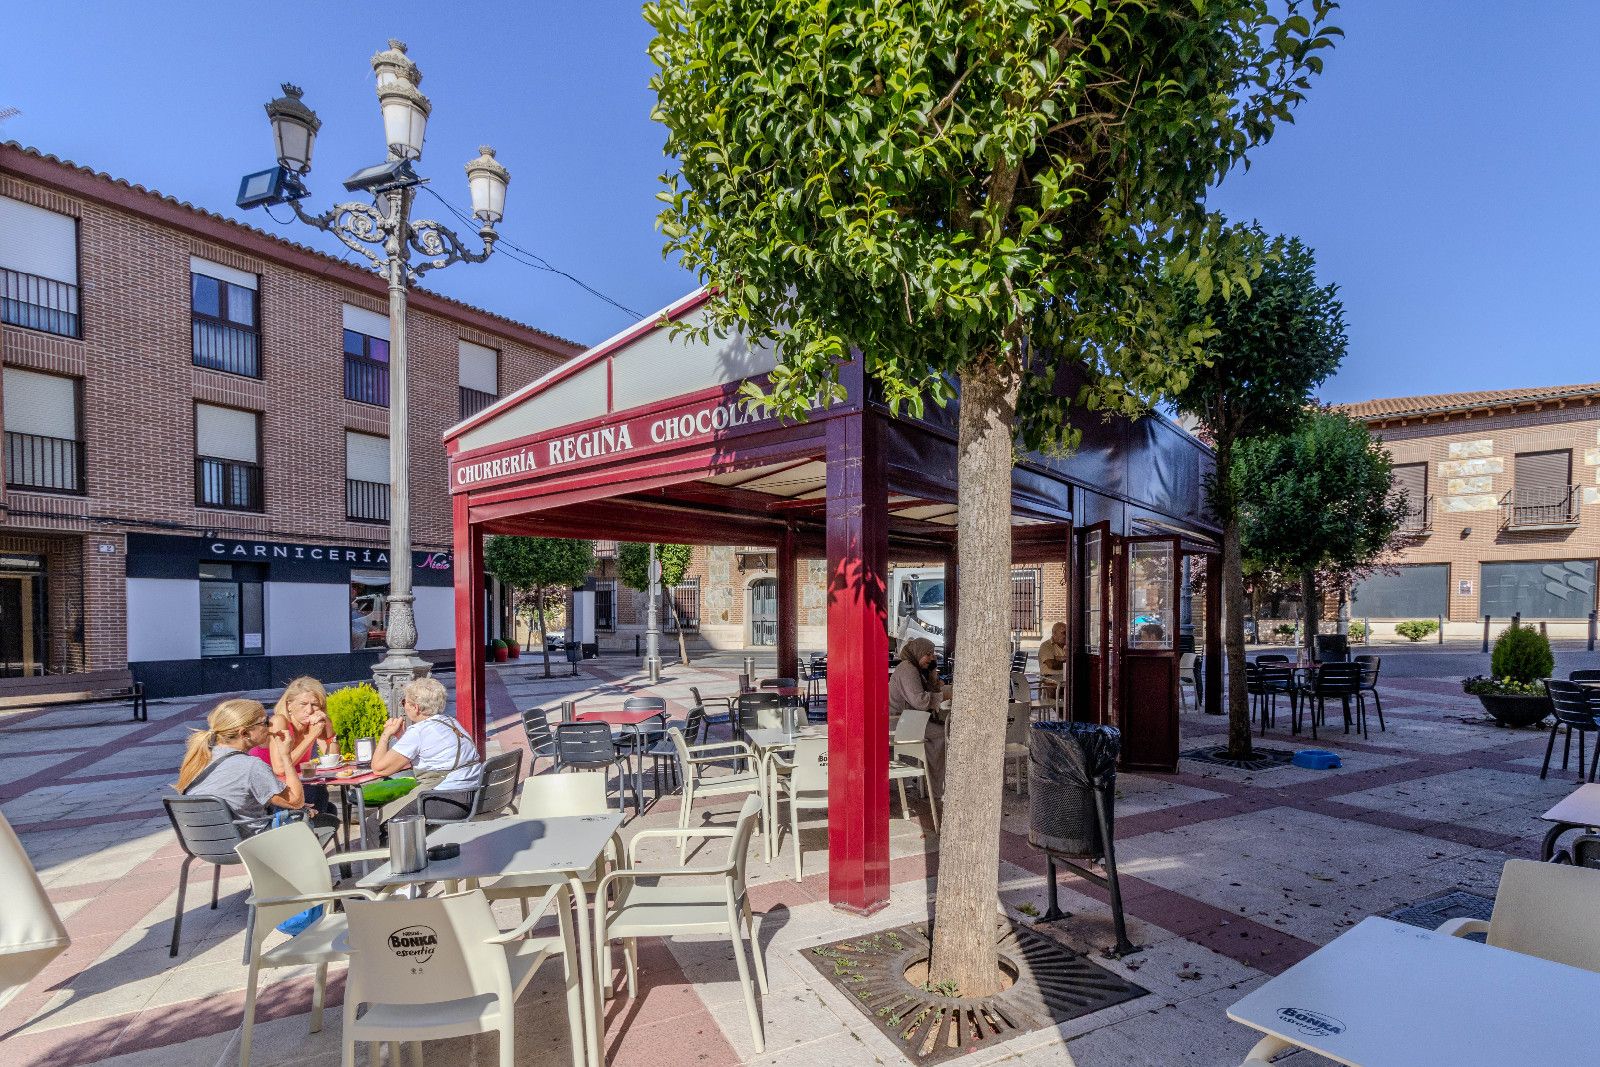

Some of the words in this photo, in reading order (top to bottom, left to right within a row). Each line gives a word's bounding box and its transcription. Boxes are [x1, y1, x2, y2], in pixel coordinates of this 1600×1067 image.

[457, 448, 537, 485] CHURRERÍA
[549, 424, 633, 466] REGINA
[211, 543, 388, 563] CARNICERÍA
[391, 936, 437, 948] BONKA
